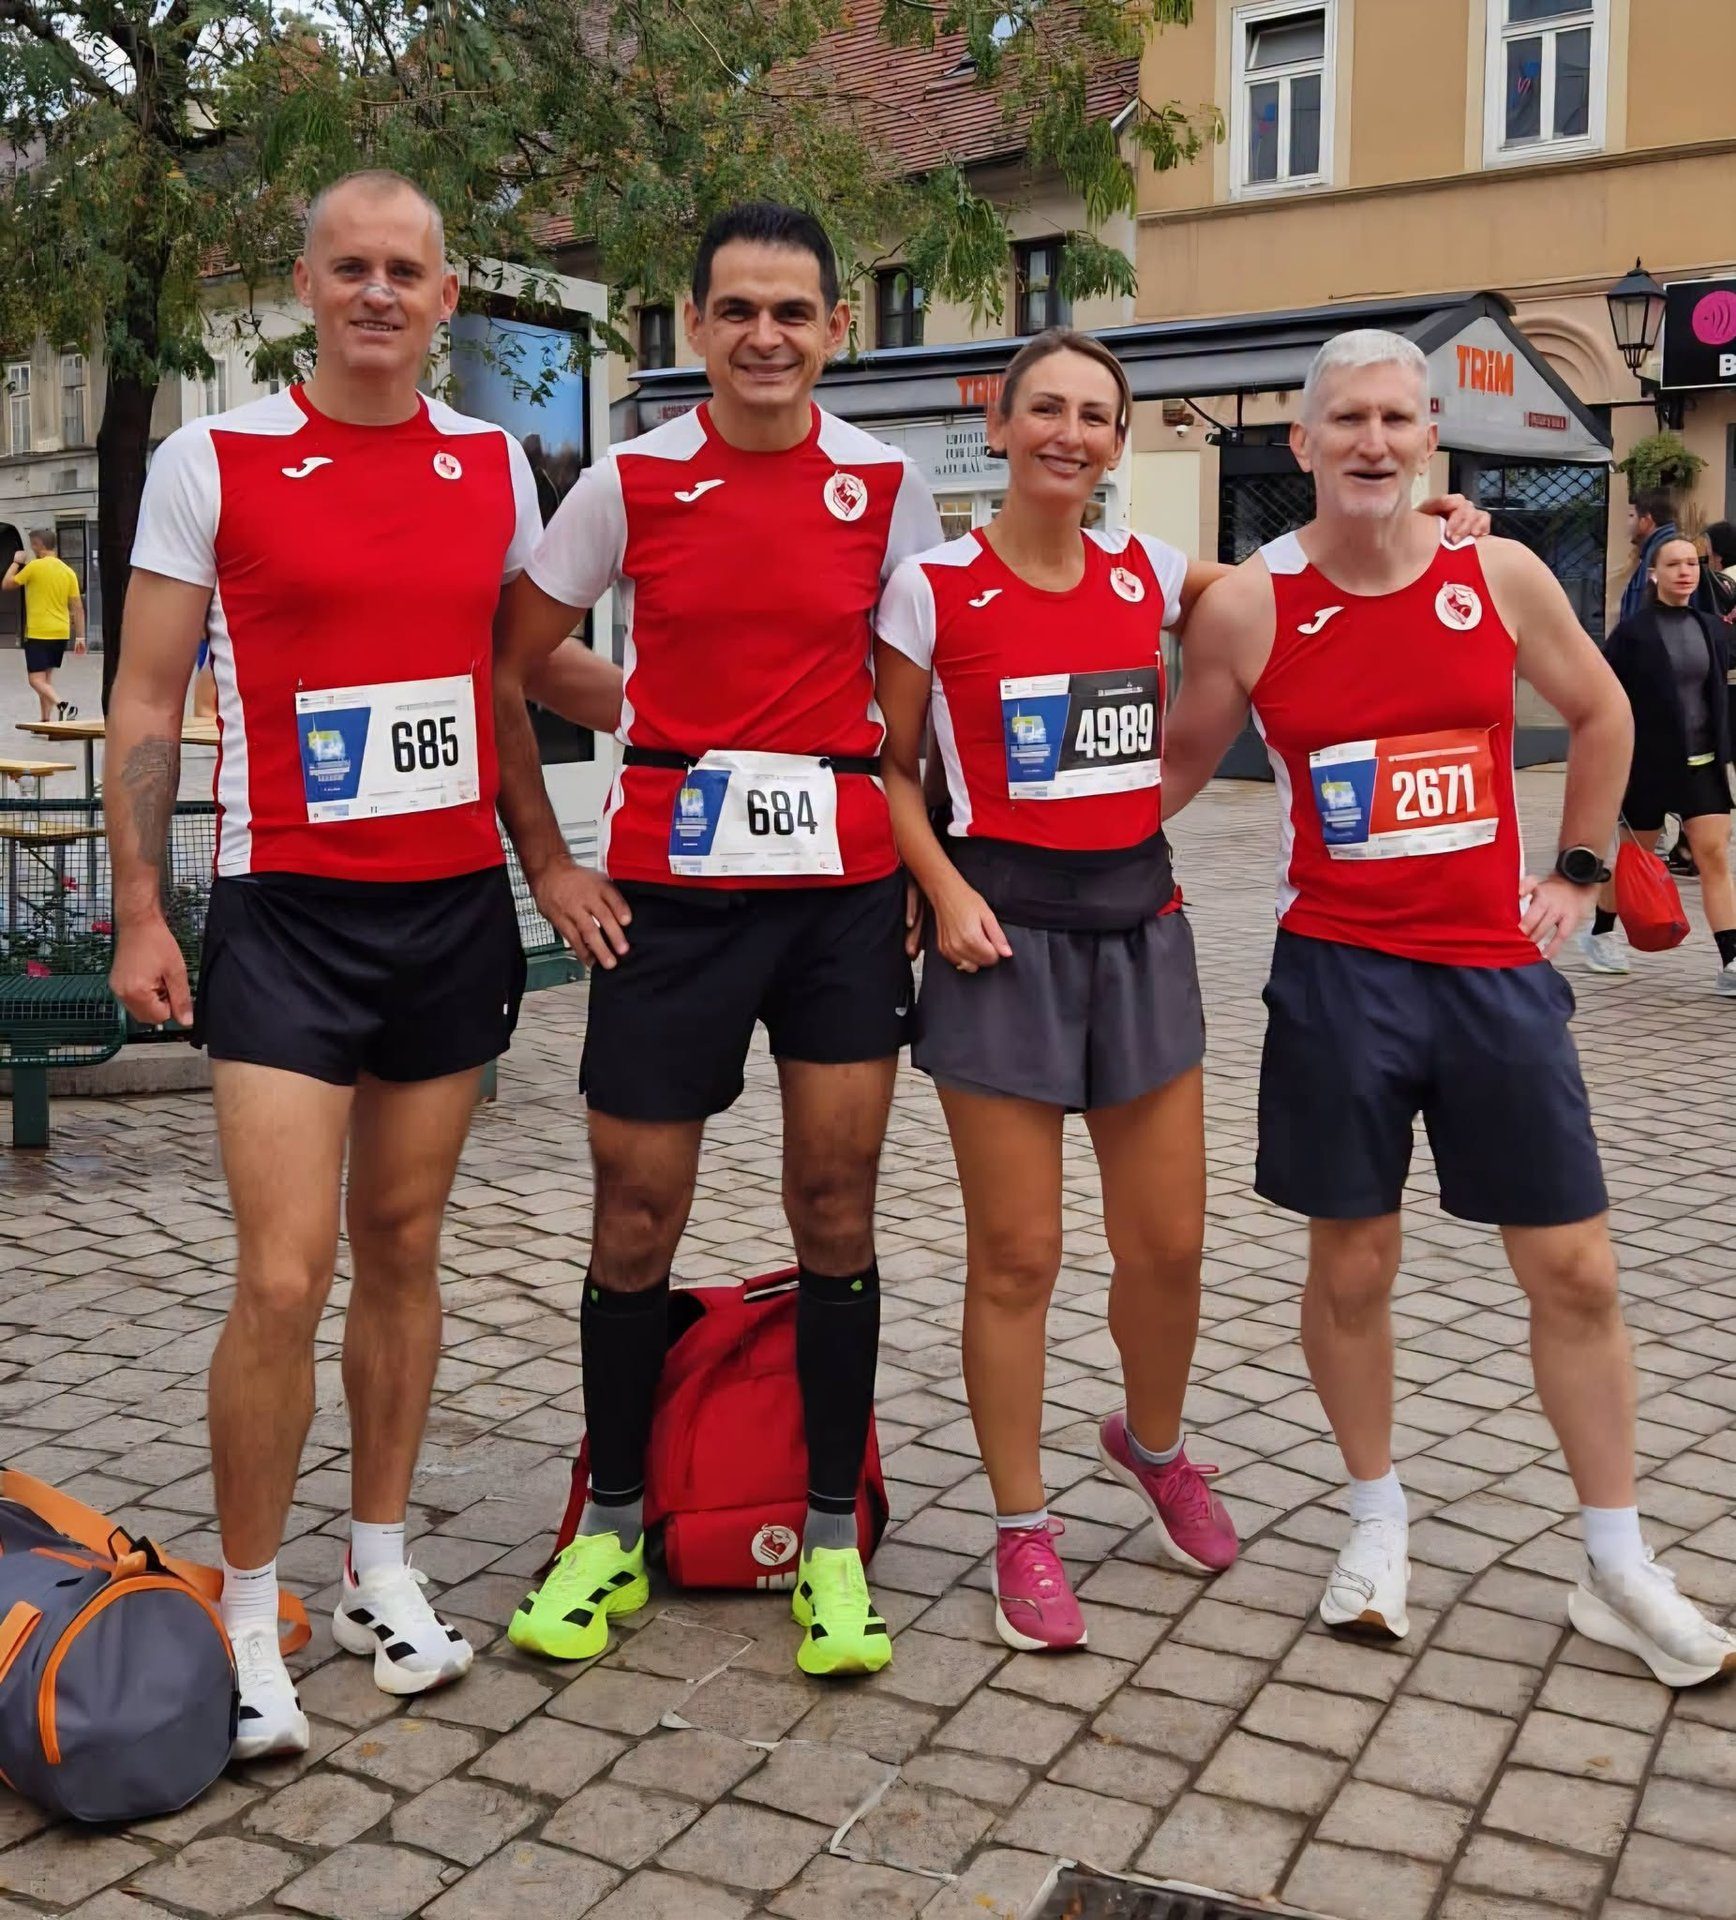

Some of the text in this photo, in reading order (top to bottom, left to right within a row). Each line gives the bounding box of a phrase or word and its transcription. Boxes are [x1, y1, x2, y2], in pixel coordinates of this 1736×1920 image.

[391, 715, 459, 773] 685
[1074, 702, 1155, 759] 4989
[747, 788, 819, 836] 684
[1391, 762, 1477, 821] 2671
